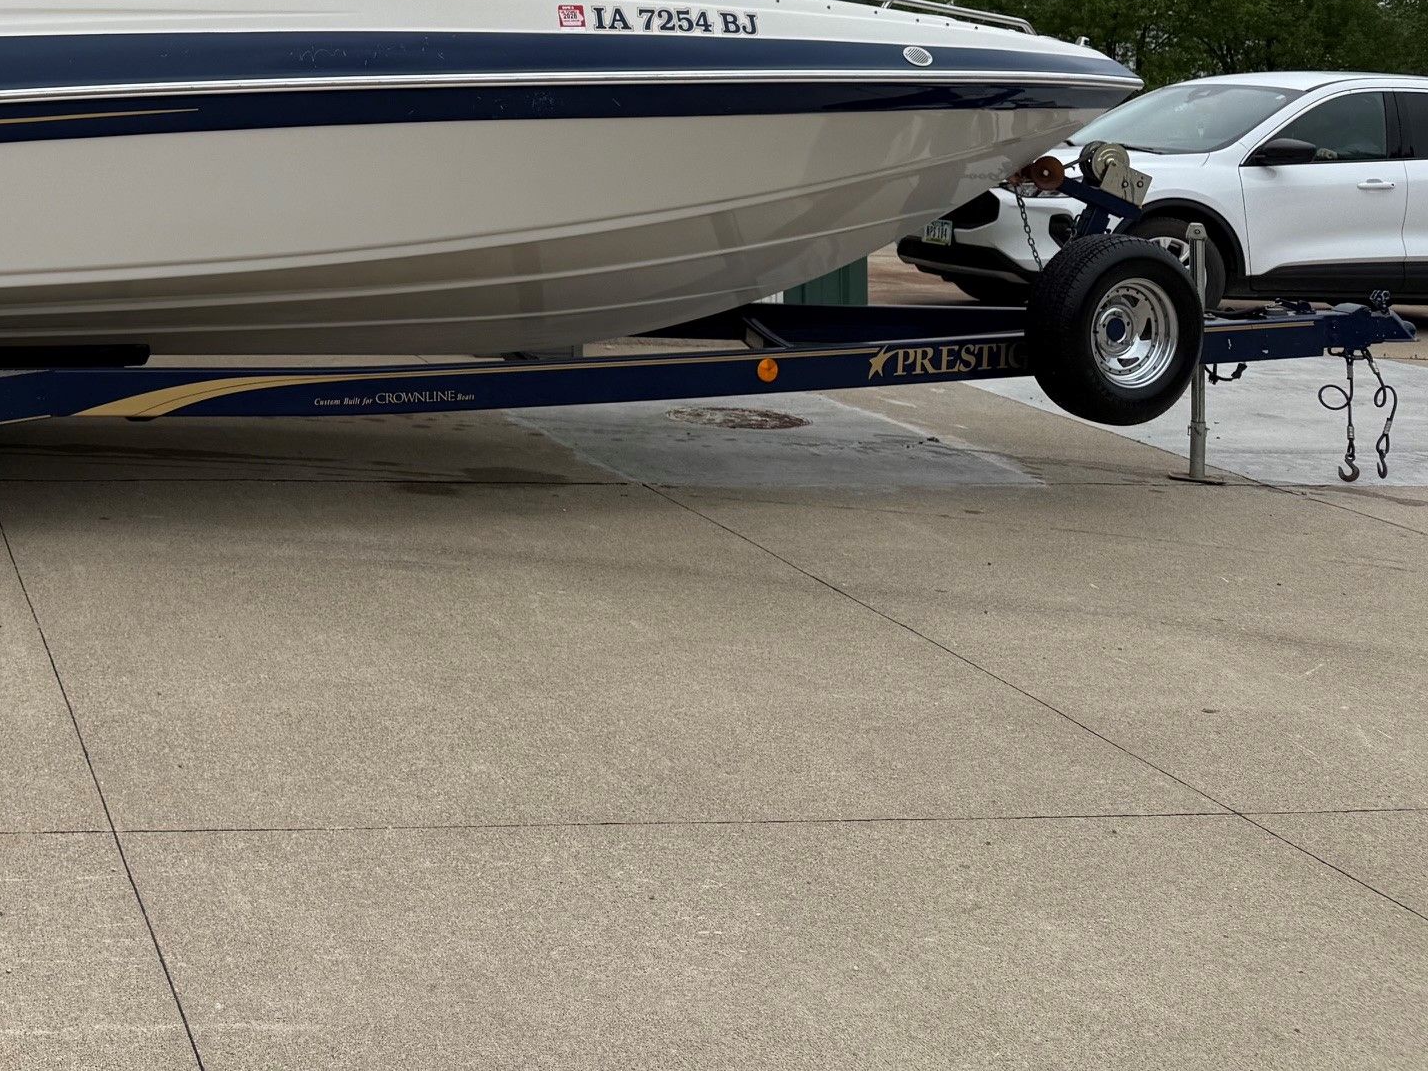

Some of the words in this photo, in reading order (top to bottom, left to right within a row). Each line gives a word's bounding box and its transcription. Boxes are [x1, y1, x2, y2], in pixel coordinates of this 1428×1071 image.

[592, 6, 633, 30] IA
[638, 8, 713, 33] 7254
[719, 11, 758, 35] BJ
[893, 342, 1029, 376] PRESTIG
[313, 397, 341, 406] Custom
[343, 396, 360, 406] Built
[361, 396, 373, 407] for
[375, 390, 455, 405] CROWNLINE
[456, 393, 475, 401] Boats
